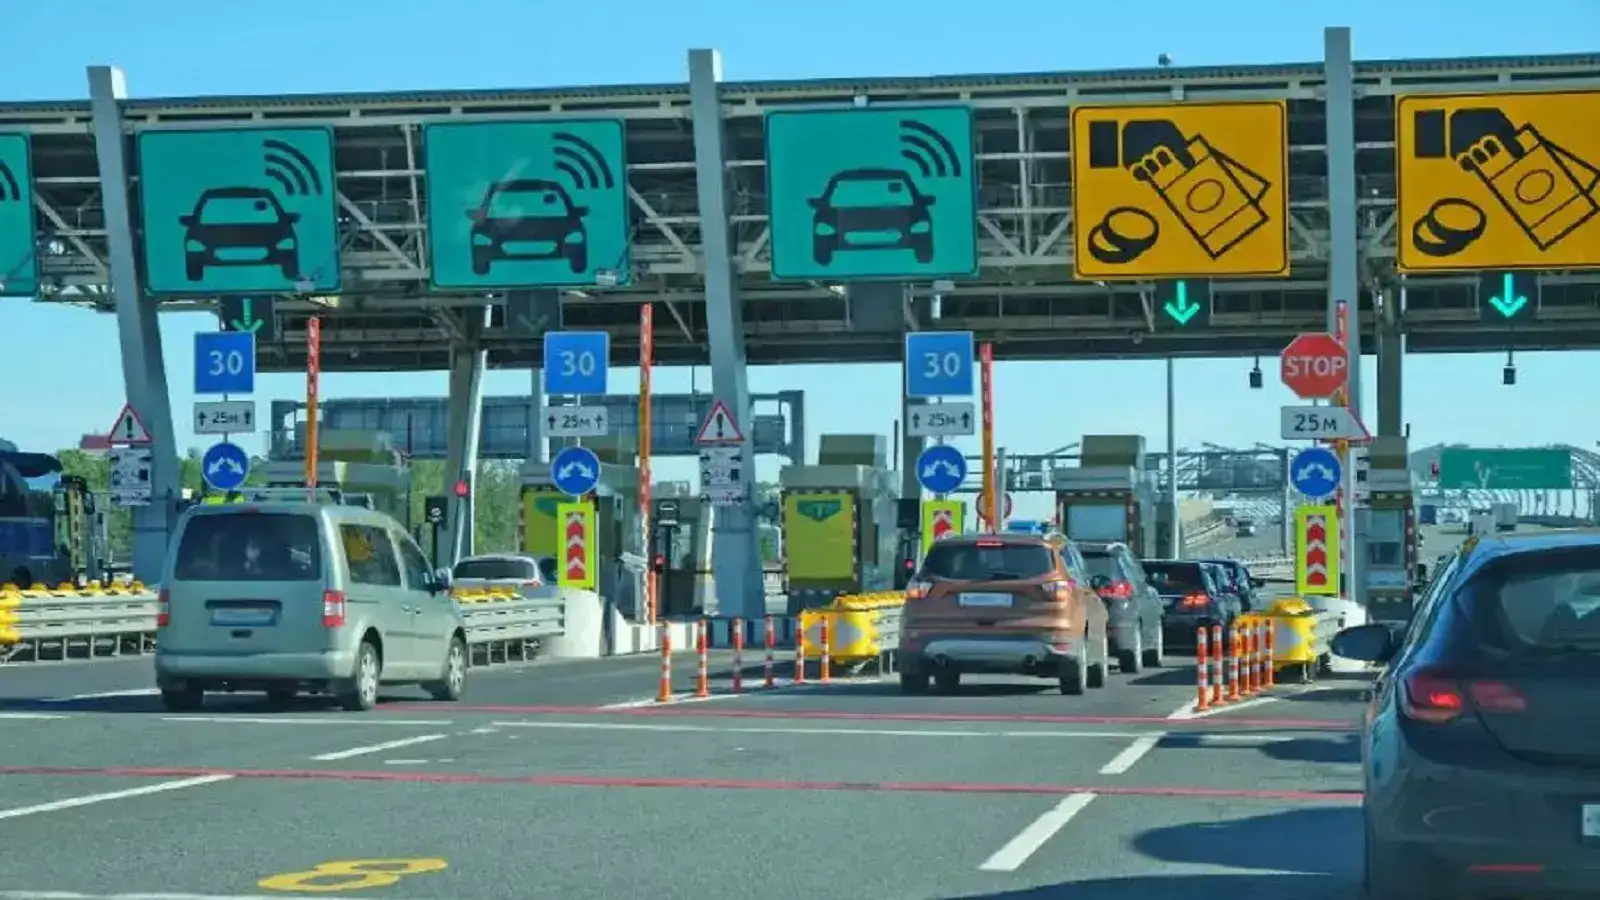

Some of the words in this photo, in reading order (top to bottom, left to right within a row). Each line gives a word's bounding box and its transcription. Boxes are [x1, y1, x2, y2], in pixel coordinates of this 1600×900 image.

[208, 350, 243, 376] 30
[560, 350, 595, 377] 30
[923, 351, 961, 378] 30
[1285, 355, 1346, 378] STOP
[258, 857, 448, 892] 8
